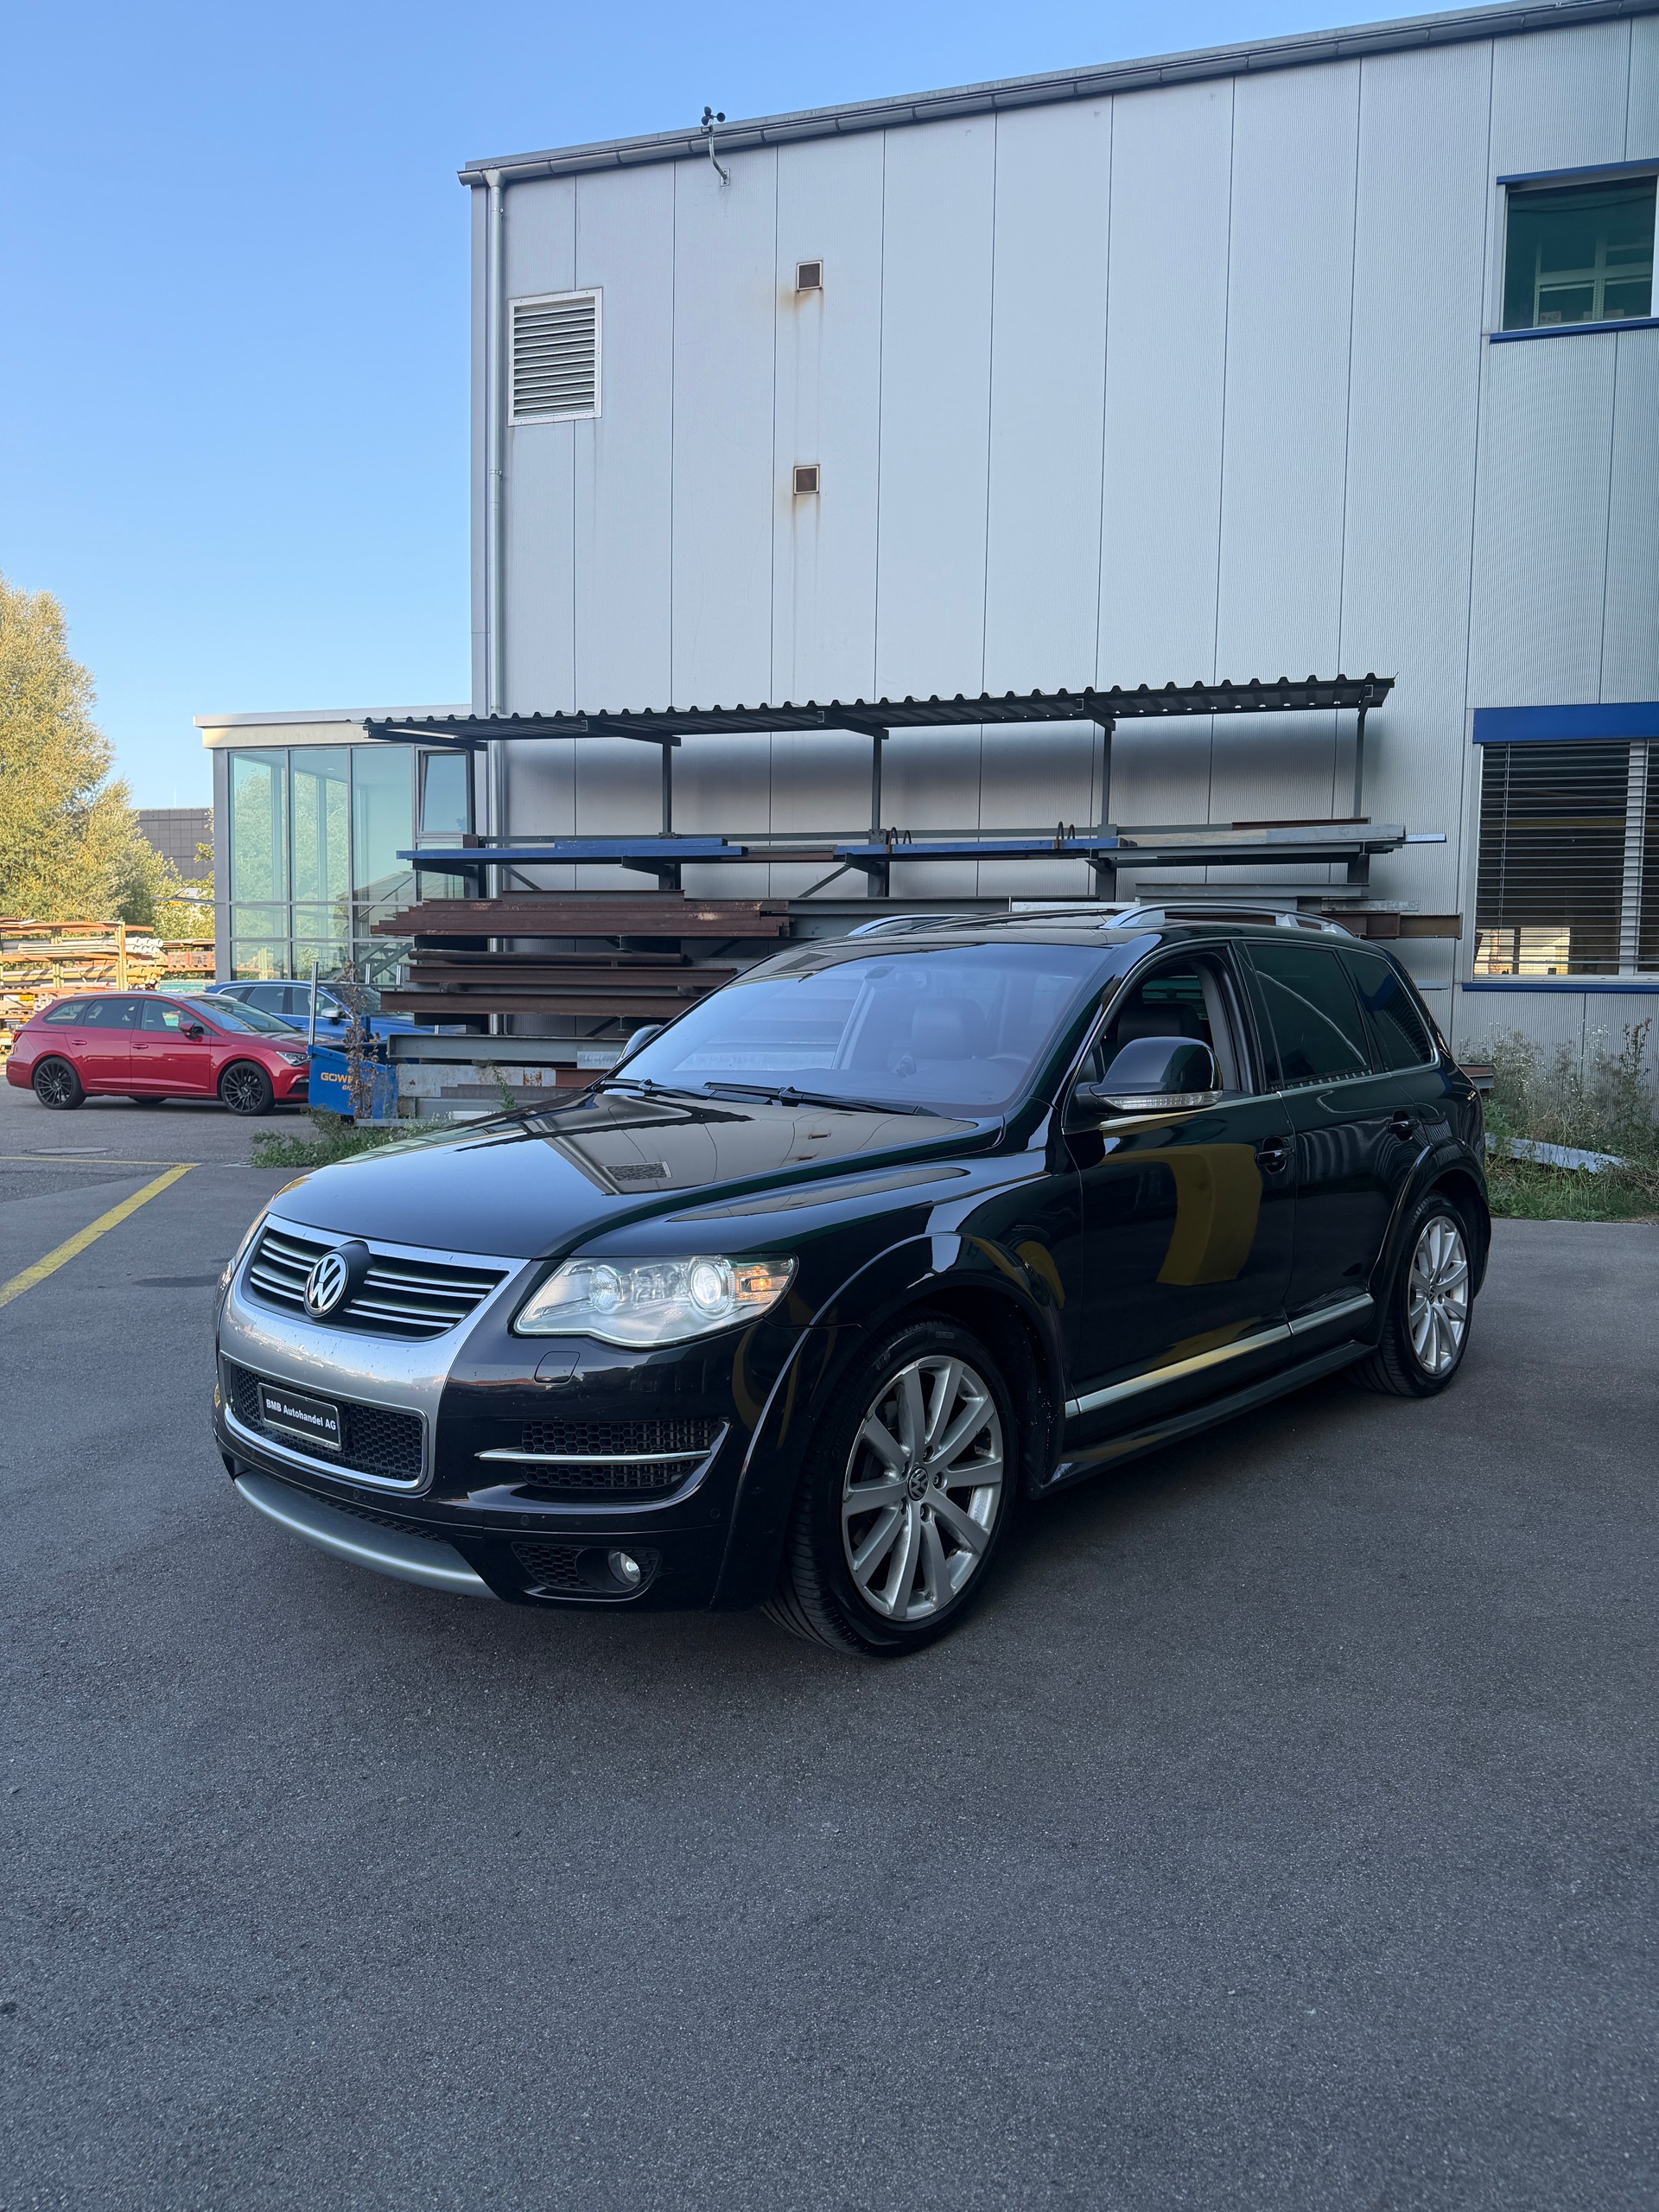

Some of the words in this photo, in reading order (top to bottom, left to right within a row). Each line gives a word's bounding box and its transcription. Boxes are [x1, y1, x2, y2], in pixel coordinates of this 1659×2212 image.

[304, 1252, 348, 1318] VW
[266, 1399, 282, 1413] BMB
[283, 1405, 323, 1427] Autohandel
[325, 1419, 336, 1431] AG
